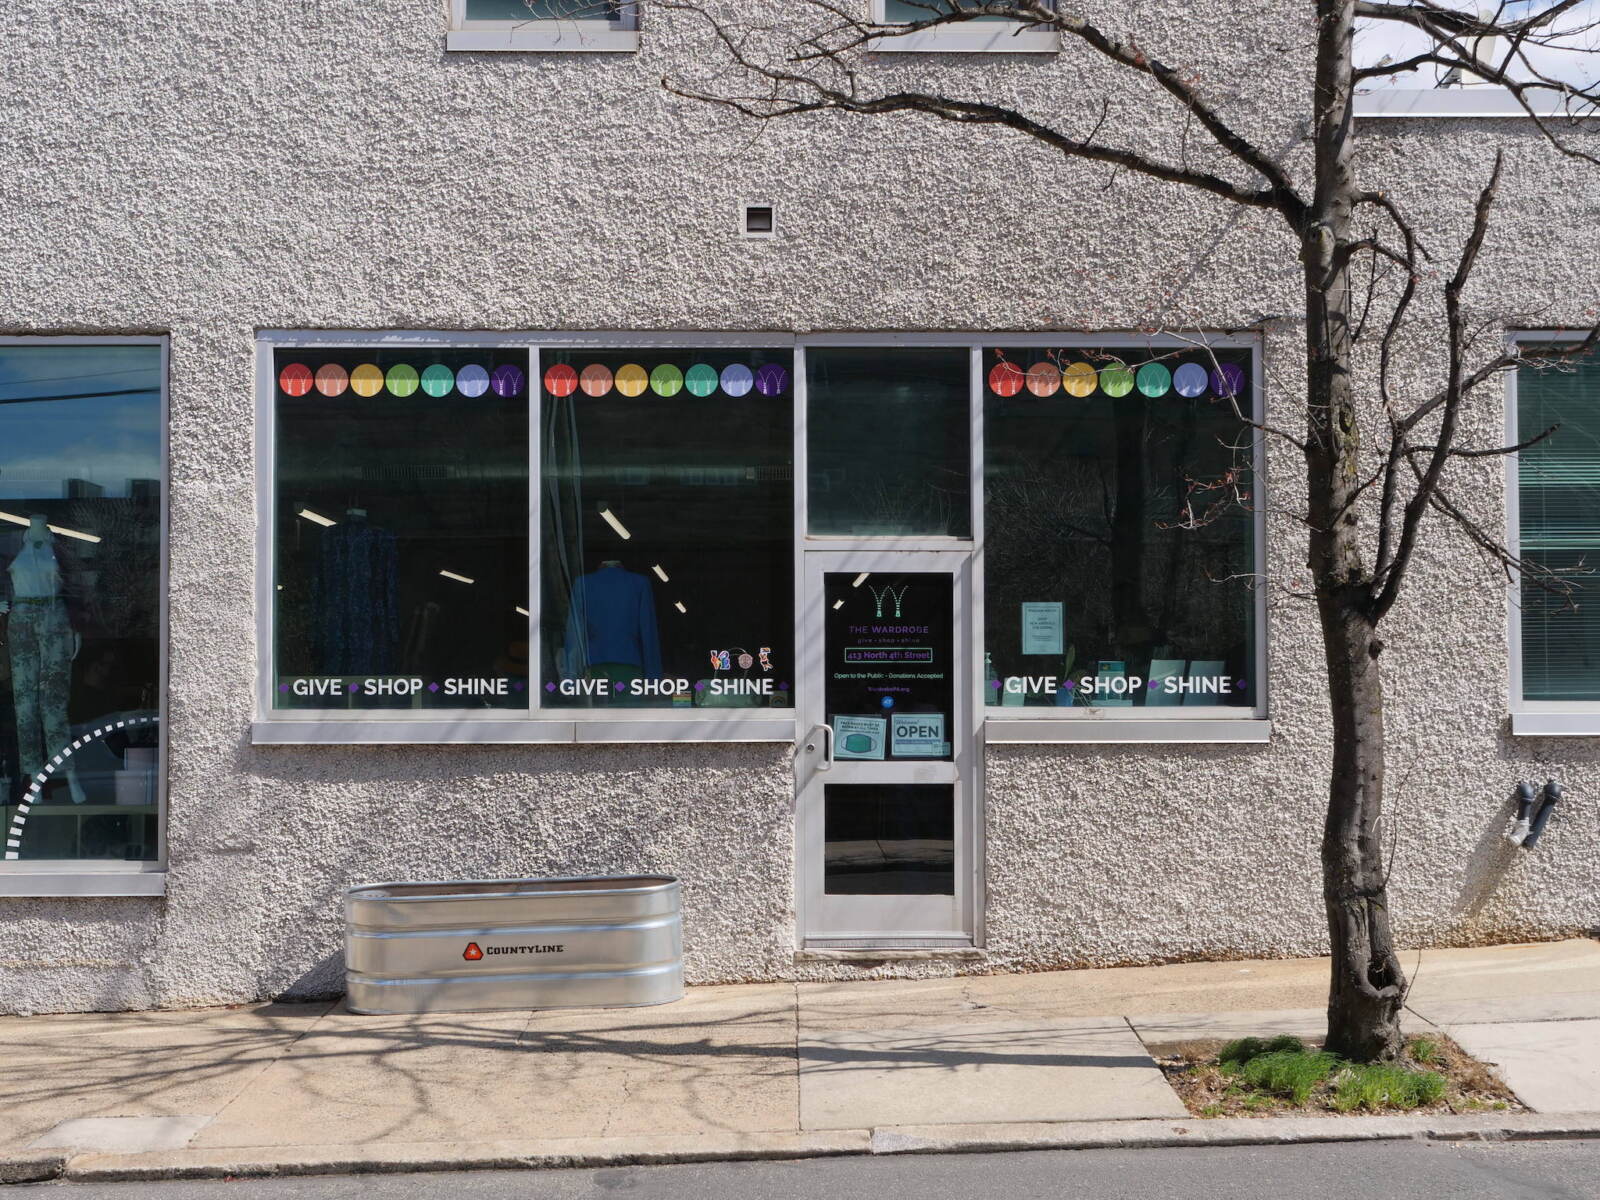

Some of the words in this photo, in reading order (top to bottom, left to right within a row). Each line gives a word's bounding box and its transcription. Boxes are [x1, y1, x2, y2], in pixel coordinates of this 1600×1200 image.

[293, 679, 342, 695] GIVE
[364, 679, 423, 695] SHOP
[444, 678, 509, 694] SHINE
[560, 679, 608, 695] GIVE
[630, 679, 689, 695] SHOP
[710, 679, 774, 695] SHINE
[1006, 676, 1057, 694] GIVE
[1080, 676, 1142, 694] SHOP
[1164, 676, 1232, 694] SHINE
[896, 726, 938, 738] OPEN
